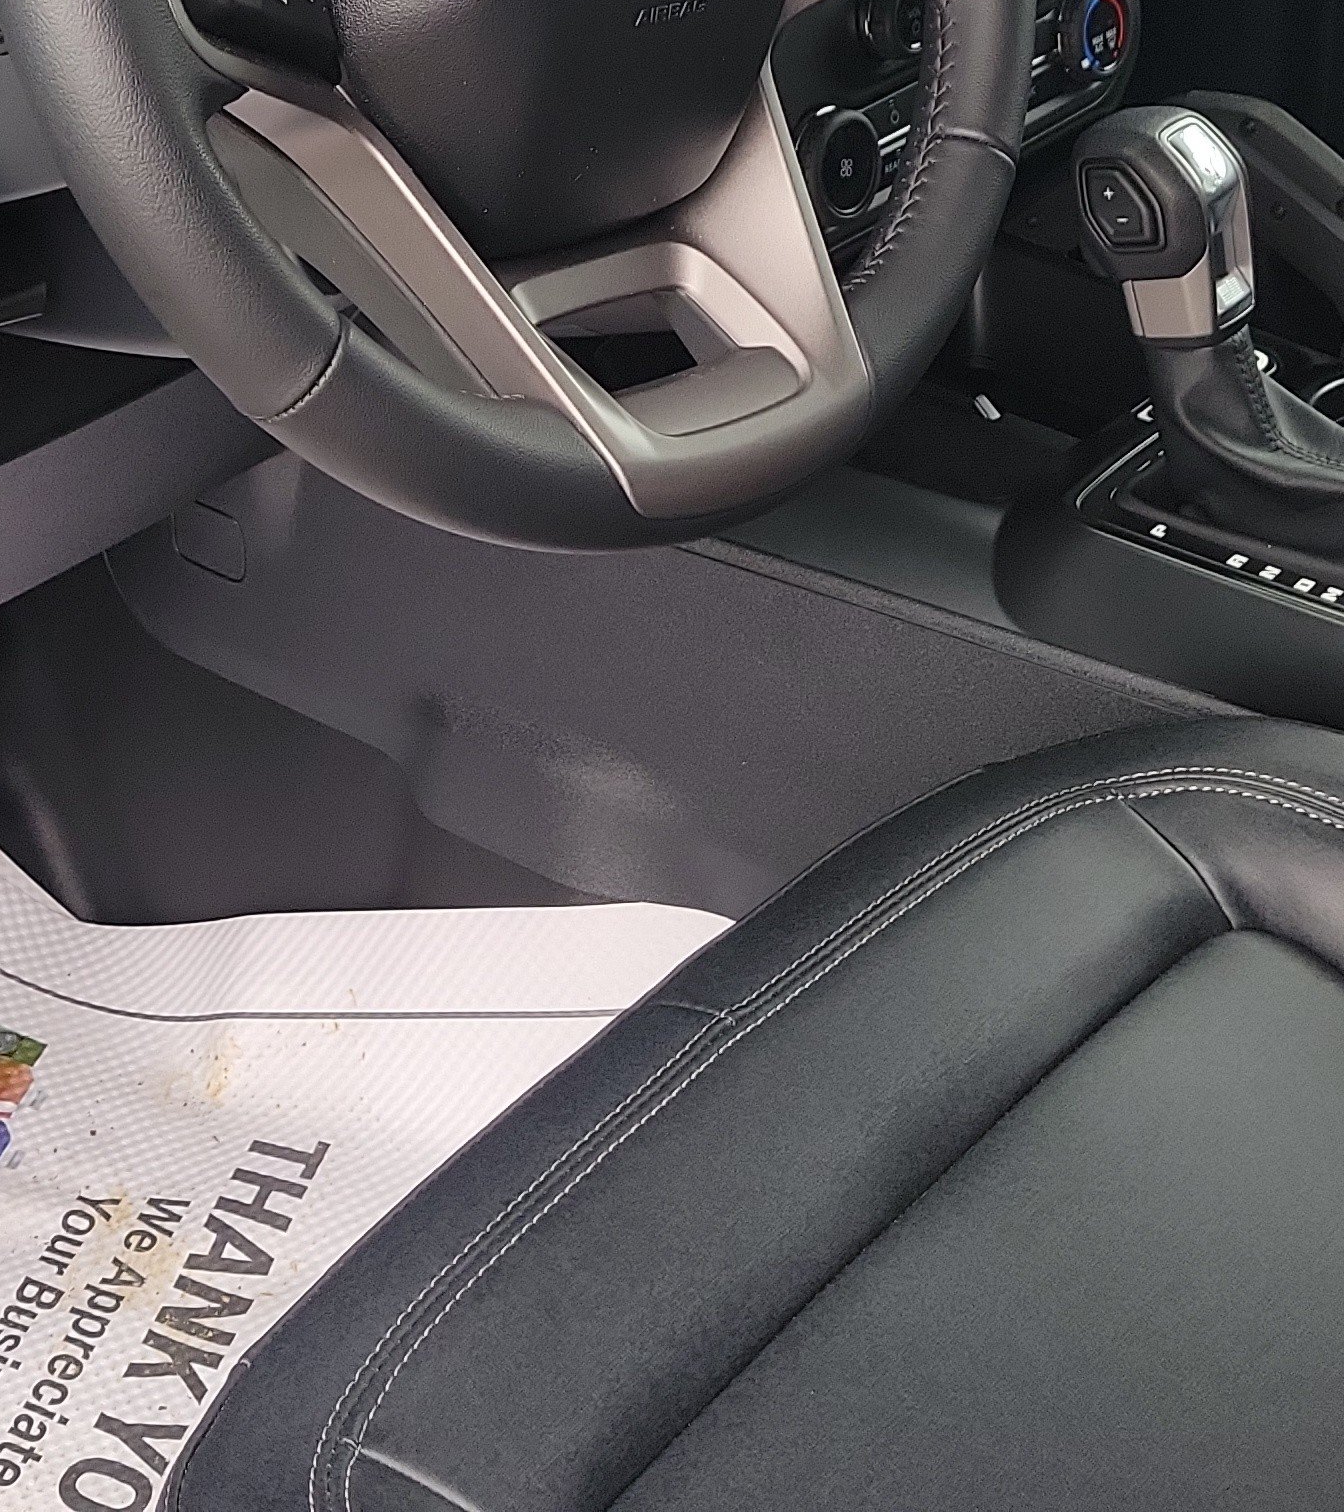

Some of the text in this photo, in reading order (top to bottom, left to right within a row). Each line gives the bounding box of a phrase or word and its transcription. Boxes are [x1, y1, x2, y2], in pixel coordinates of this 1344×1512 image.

[38, 1193, 123, 1276] Your
[124, 1196, 192, 1254] We
[58, 1139, 331, 1512] THANK YO
